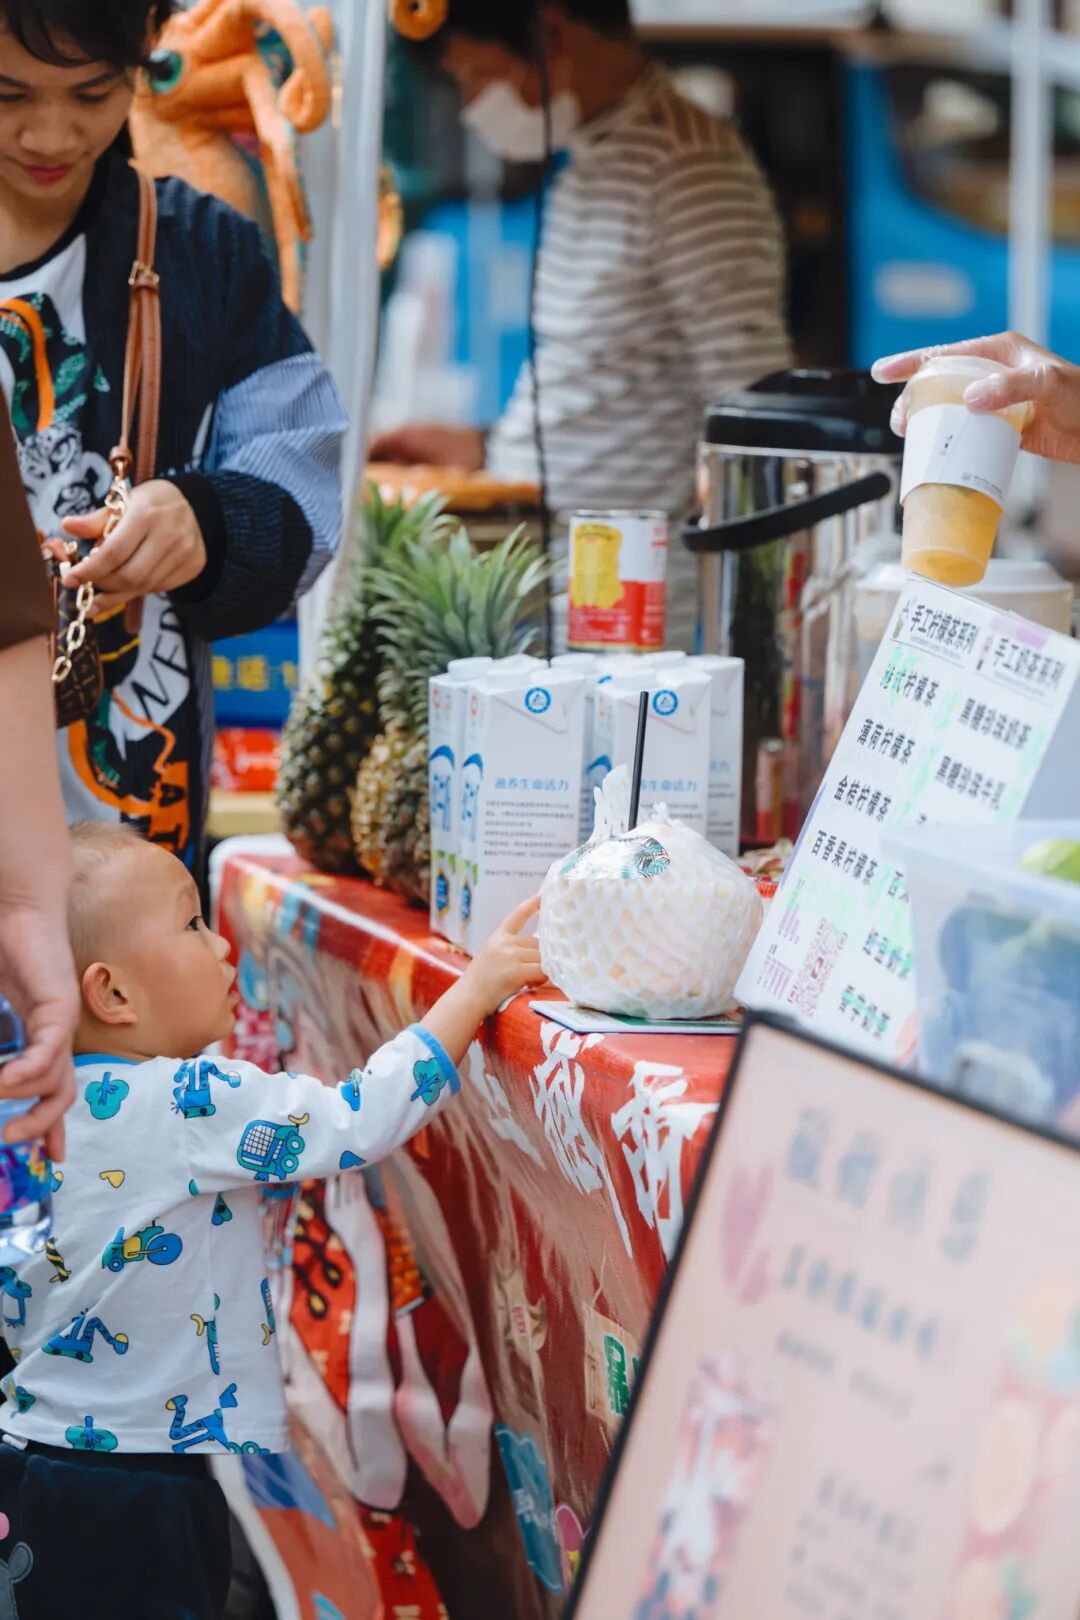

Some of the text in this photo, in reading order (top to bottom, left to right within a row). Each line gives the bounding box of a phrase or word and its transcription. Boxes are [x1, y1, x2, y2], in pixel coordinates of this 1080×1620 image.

[910, 604, 980, 654] 手工柠檬茶系列
[857, 717, 916, 765] 薄荷柠檬茶
[833, 775, 892, 822] 金桔柠檬茶
[811, 830, 878, 886] 百香果柠檬茶
